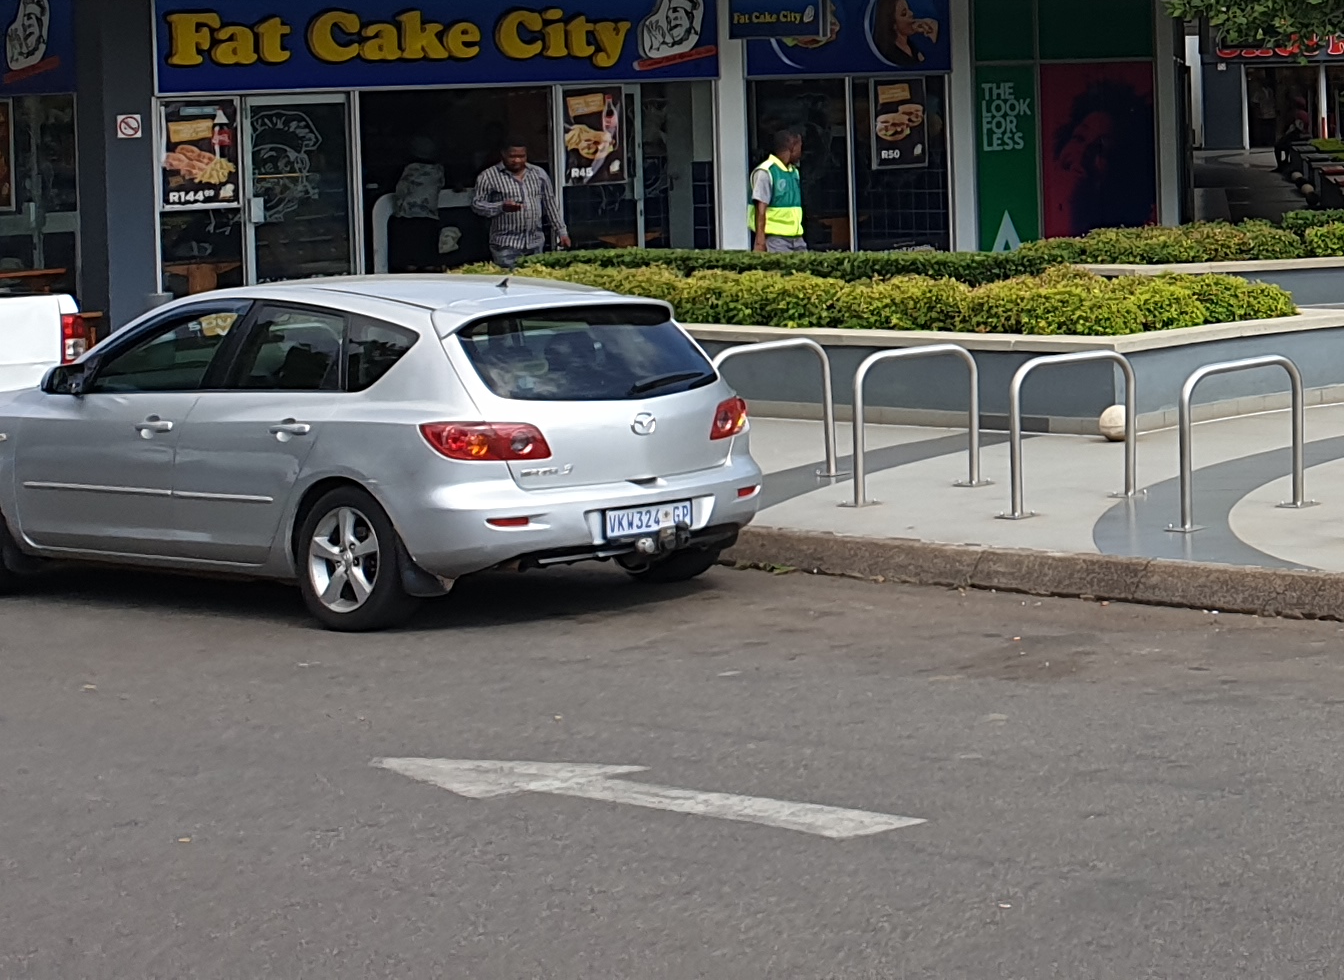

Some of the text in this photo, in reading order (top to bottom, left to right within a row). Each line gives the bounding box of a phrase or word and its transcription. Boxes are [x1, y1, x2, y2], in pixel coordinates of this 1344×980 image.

[733, 10, 802, 24] Fat Cake City
[166, 8, 631, 68] Fat Cake City
[981, 82, 1015, 100] THE
[982, 98, 1031, 118] LOOK
[983, 116, 1017, 134] FOR
[983, 132, 1024, 152] LESS
[881, 149, 900, 159] R50
[609, 504, 690, 534] VKW324 GP
